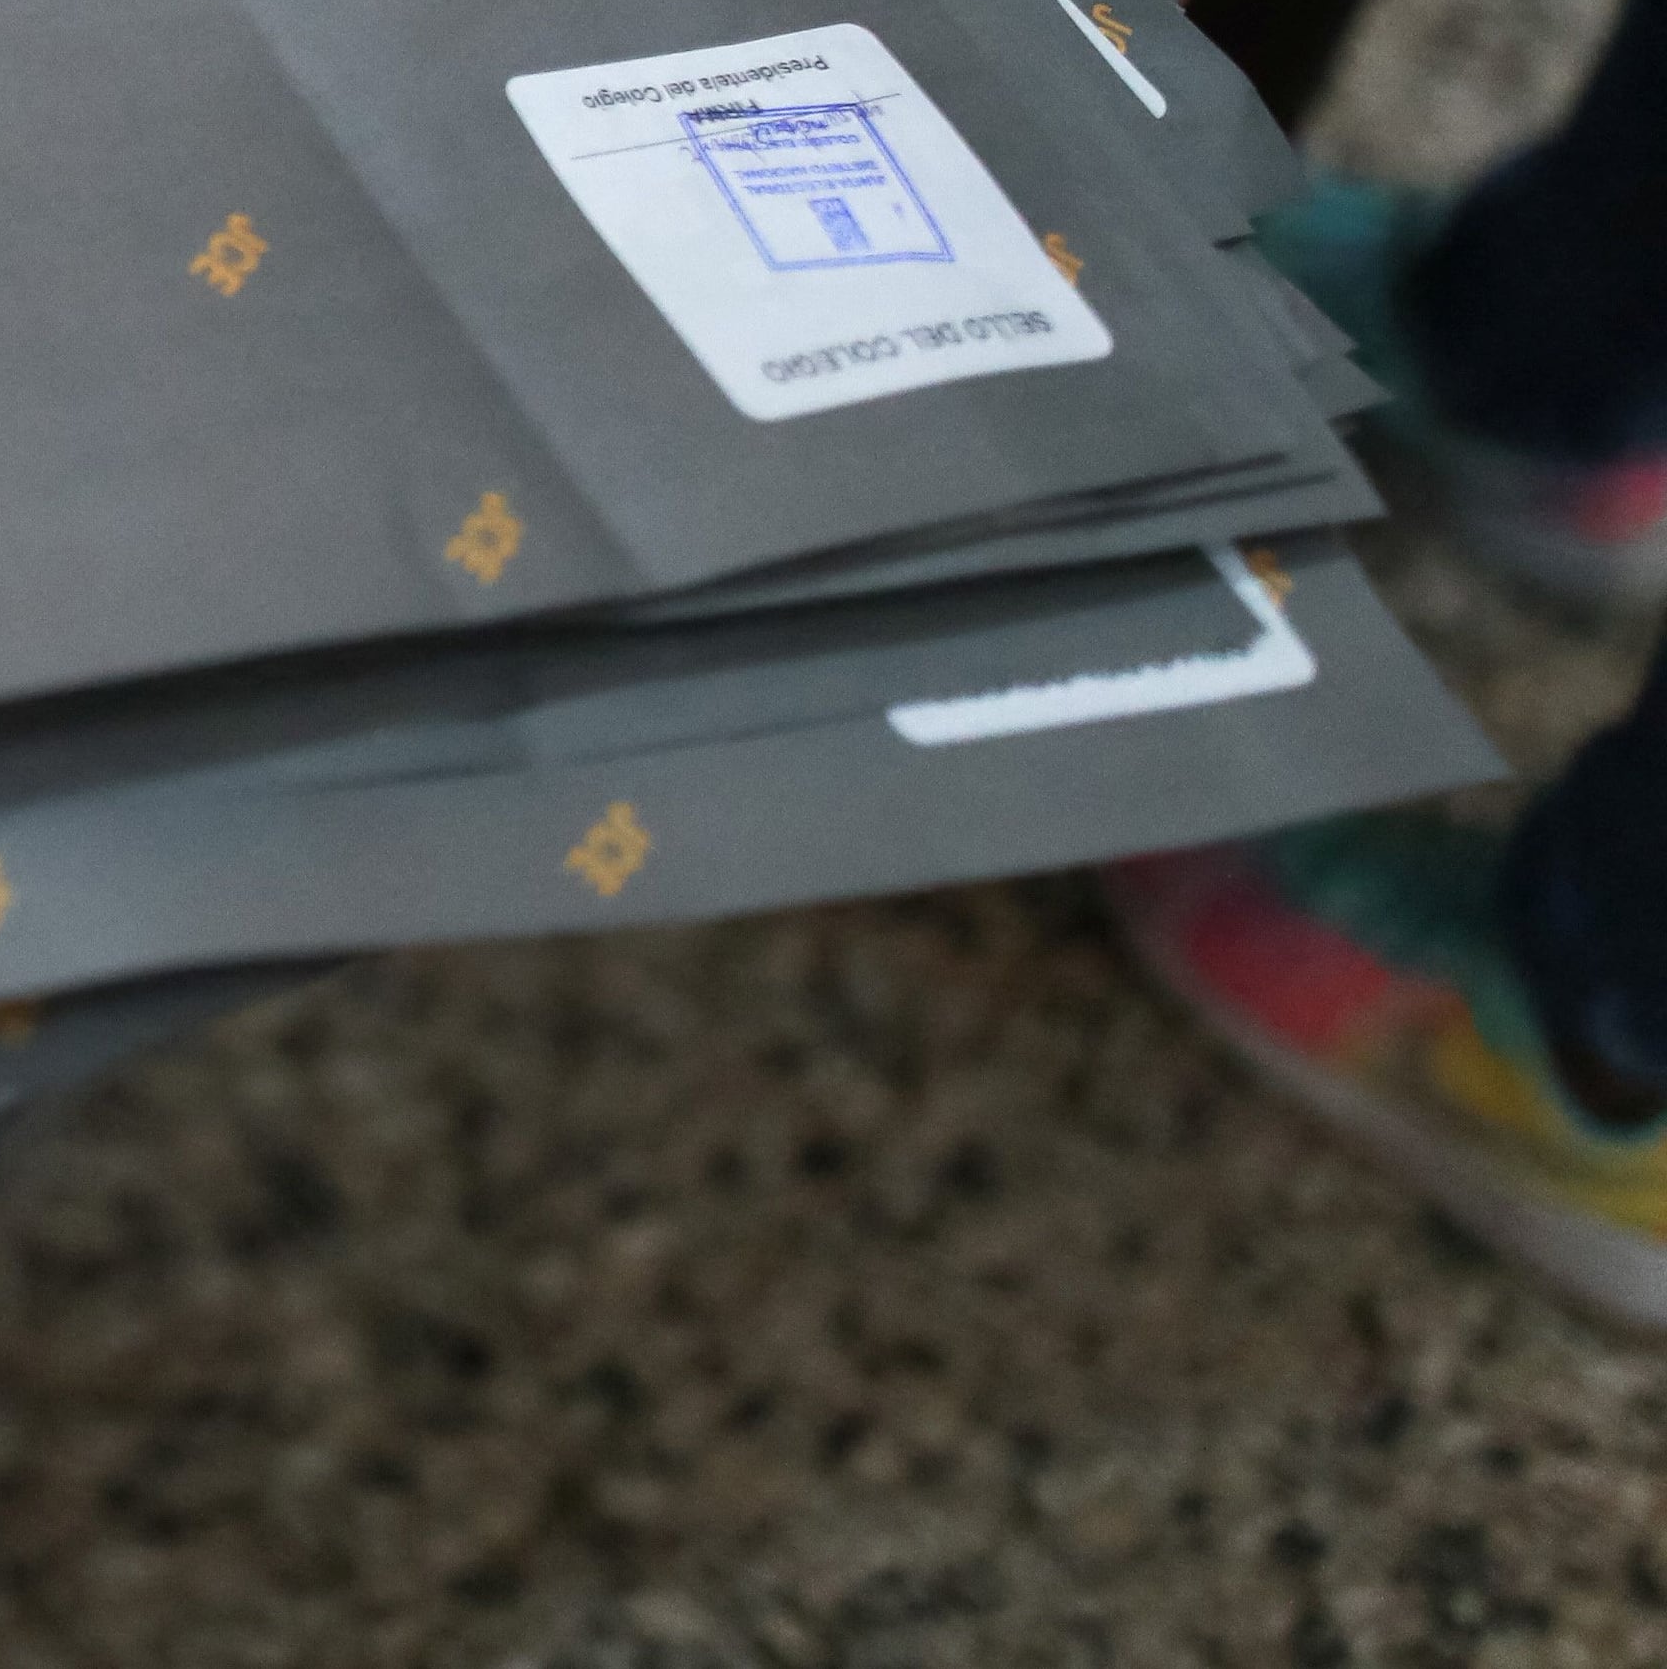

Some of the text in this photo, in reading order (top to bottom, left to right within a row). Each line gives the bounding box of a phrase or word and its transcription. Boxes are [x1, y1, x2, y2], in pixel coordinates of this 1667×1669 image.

[581, 86, 662, 113] Colegio
[662, 77, 696, 101] del
[761, 311, 1054, 384] SELLO DEL COLEGIO
